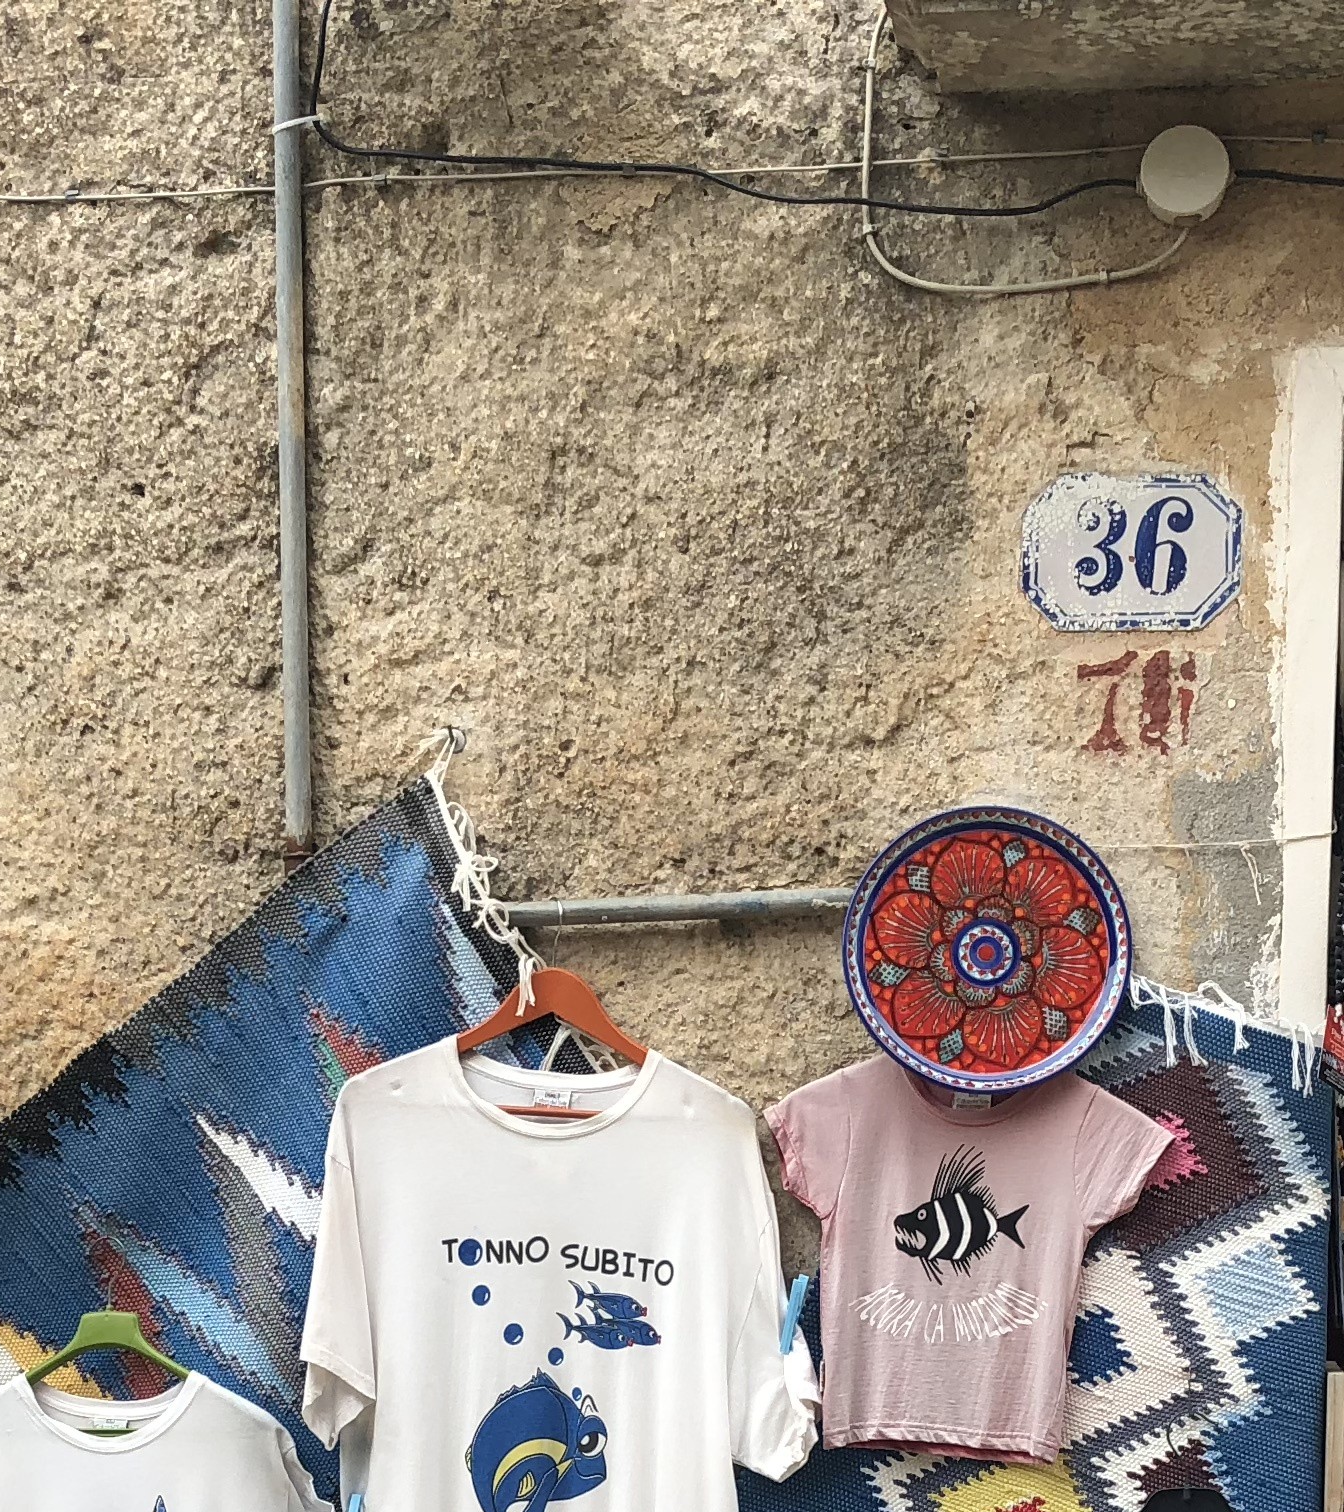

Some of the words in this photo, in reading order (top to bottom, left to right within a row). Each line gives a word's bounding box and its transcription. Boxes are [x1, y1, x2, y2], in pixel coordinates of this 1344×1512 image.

[1075, 496, 1194, 596] 36
[560, 1244, 674, 1286] SUBITO
[924, 1303, 944, 1343] CA
